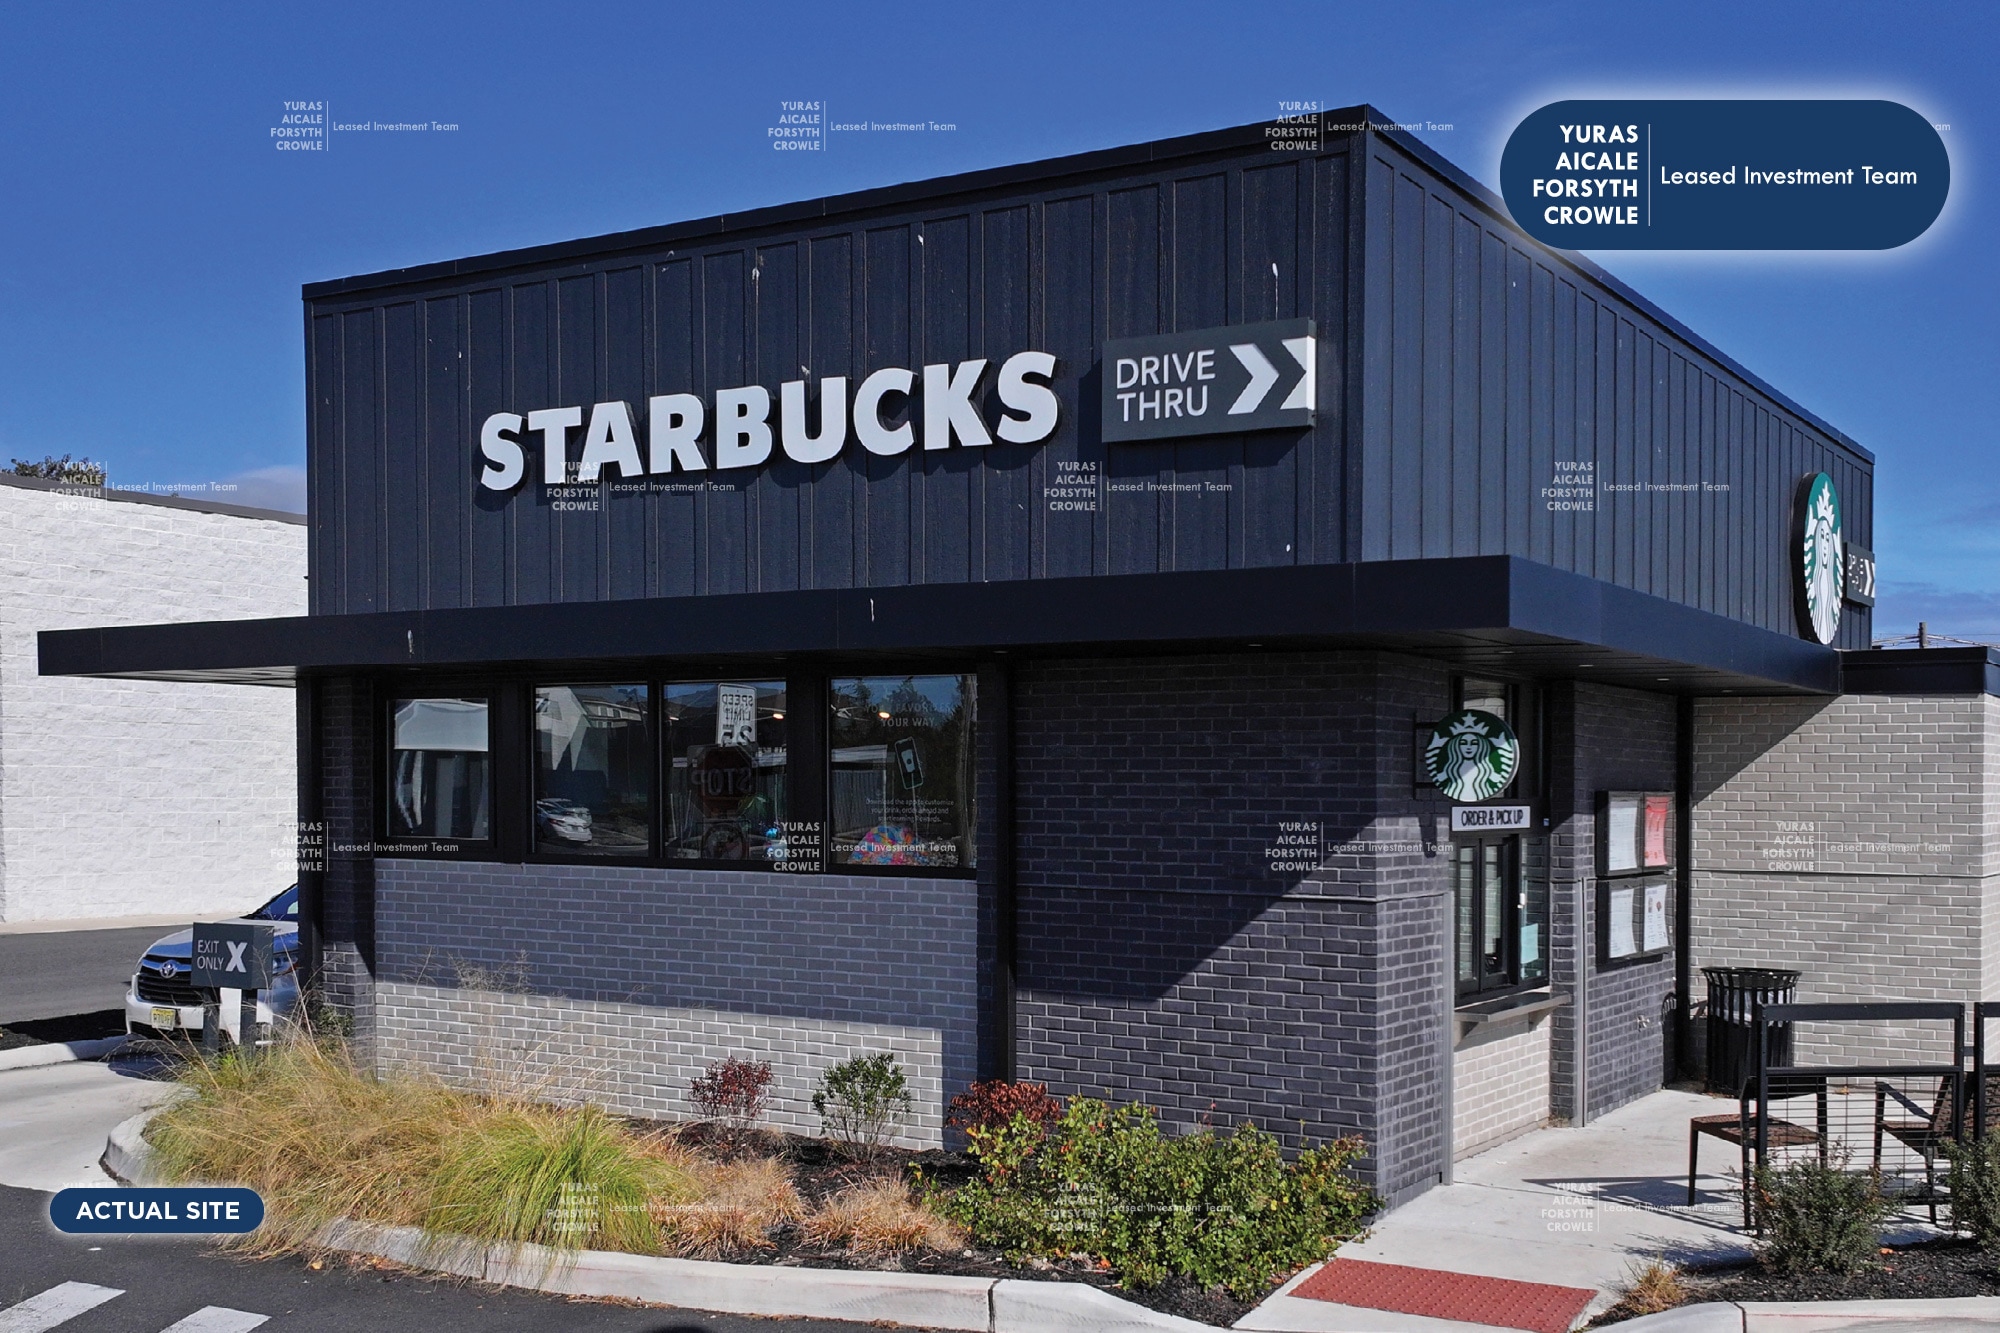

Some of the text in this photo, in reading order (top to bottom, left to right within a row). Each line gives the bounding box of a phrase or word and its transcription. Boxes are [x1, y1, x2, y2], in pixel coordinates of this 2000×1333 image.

[1116, 349, 1216, 389] DRIVE
[1116, 385, 1208, 422] THRU
[480, 351, 1058, 491] STARBUCKS
[881, 717, 909, 727] YOUR
[1461, 809, 1523, 826] ORDER & PICK UP
[197, 939, 219, 954] EXIT
[197, 956, 224, 970] ONLY
